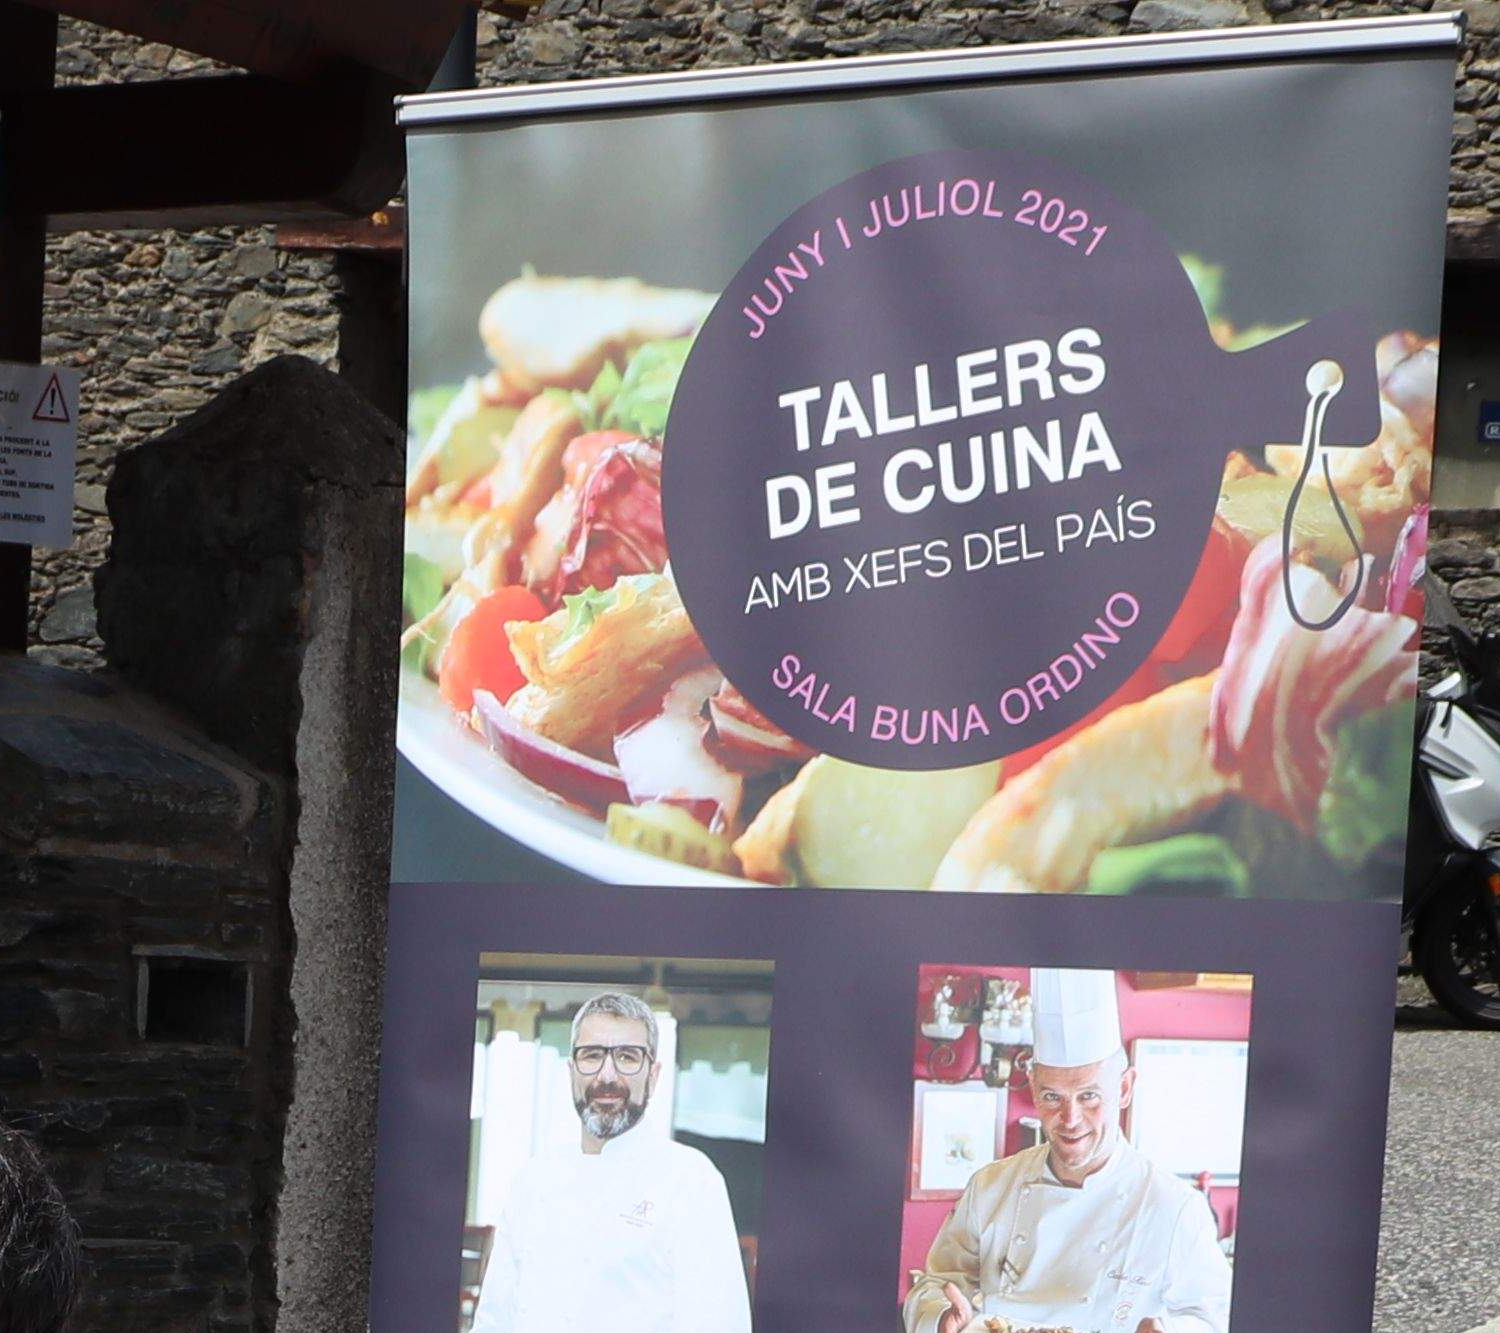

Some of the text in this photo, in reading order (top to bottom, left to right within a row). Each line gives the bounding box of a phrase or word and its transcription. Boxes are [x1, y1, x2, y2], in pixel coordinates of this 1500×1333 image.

[742, 179, 1109, 339] JUNY I JULIOL 2021
[779, 328, 1106, 451] TALLERS
[766, 411, 1122, 539] DE CUINA
[744, 494, 1156, 614] AMB XEFS DEL PAÍS
[772, 591, 1141, 745] SALA BUNA ORDINO
